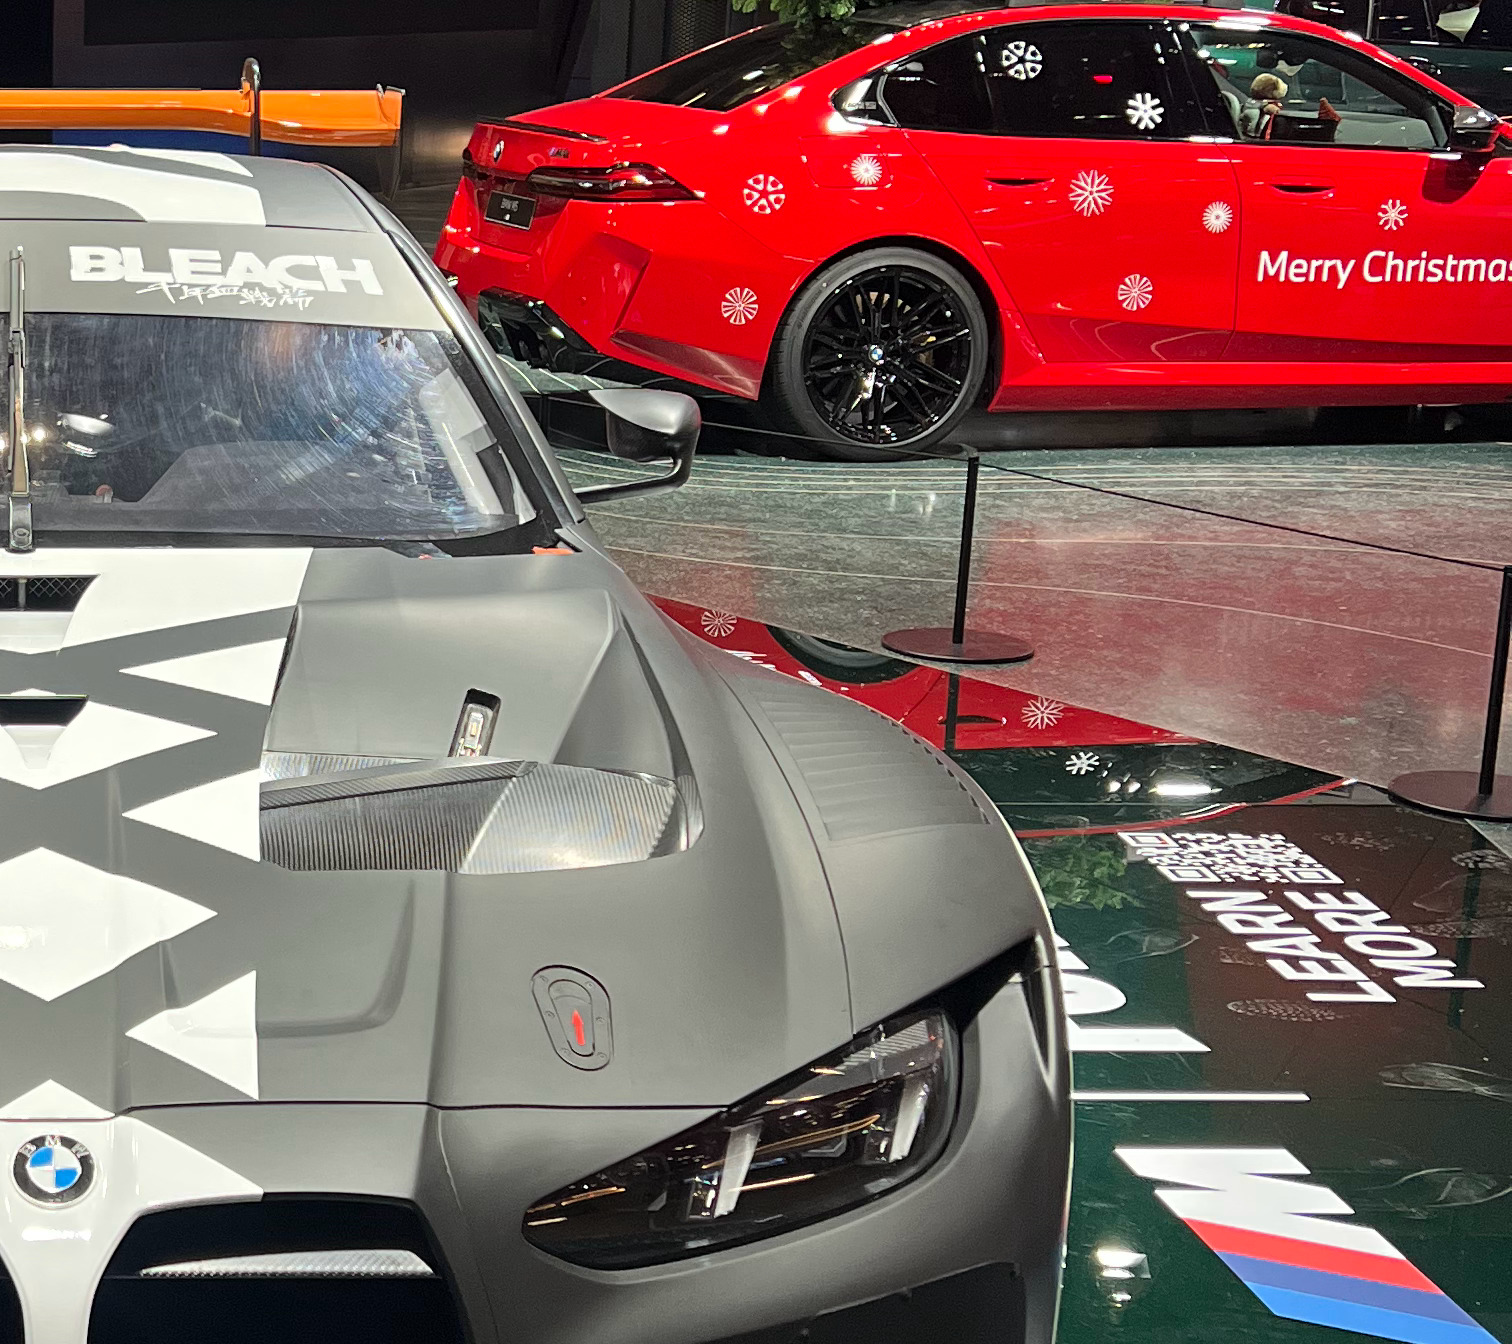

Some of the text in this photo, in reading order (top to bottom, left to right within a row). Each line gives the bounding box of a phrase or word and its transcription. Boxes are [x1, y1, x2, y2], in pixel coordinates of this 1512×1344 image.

[69, 246, 384, 295] BLEACH
[1257, 251, 1356, 289] Merry
[1186, 890, 1396, 1003] LEARN
[1284, 891, 1485, 989] MORE
[18, 1134, 90, 1159] BMW
